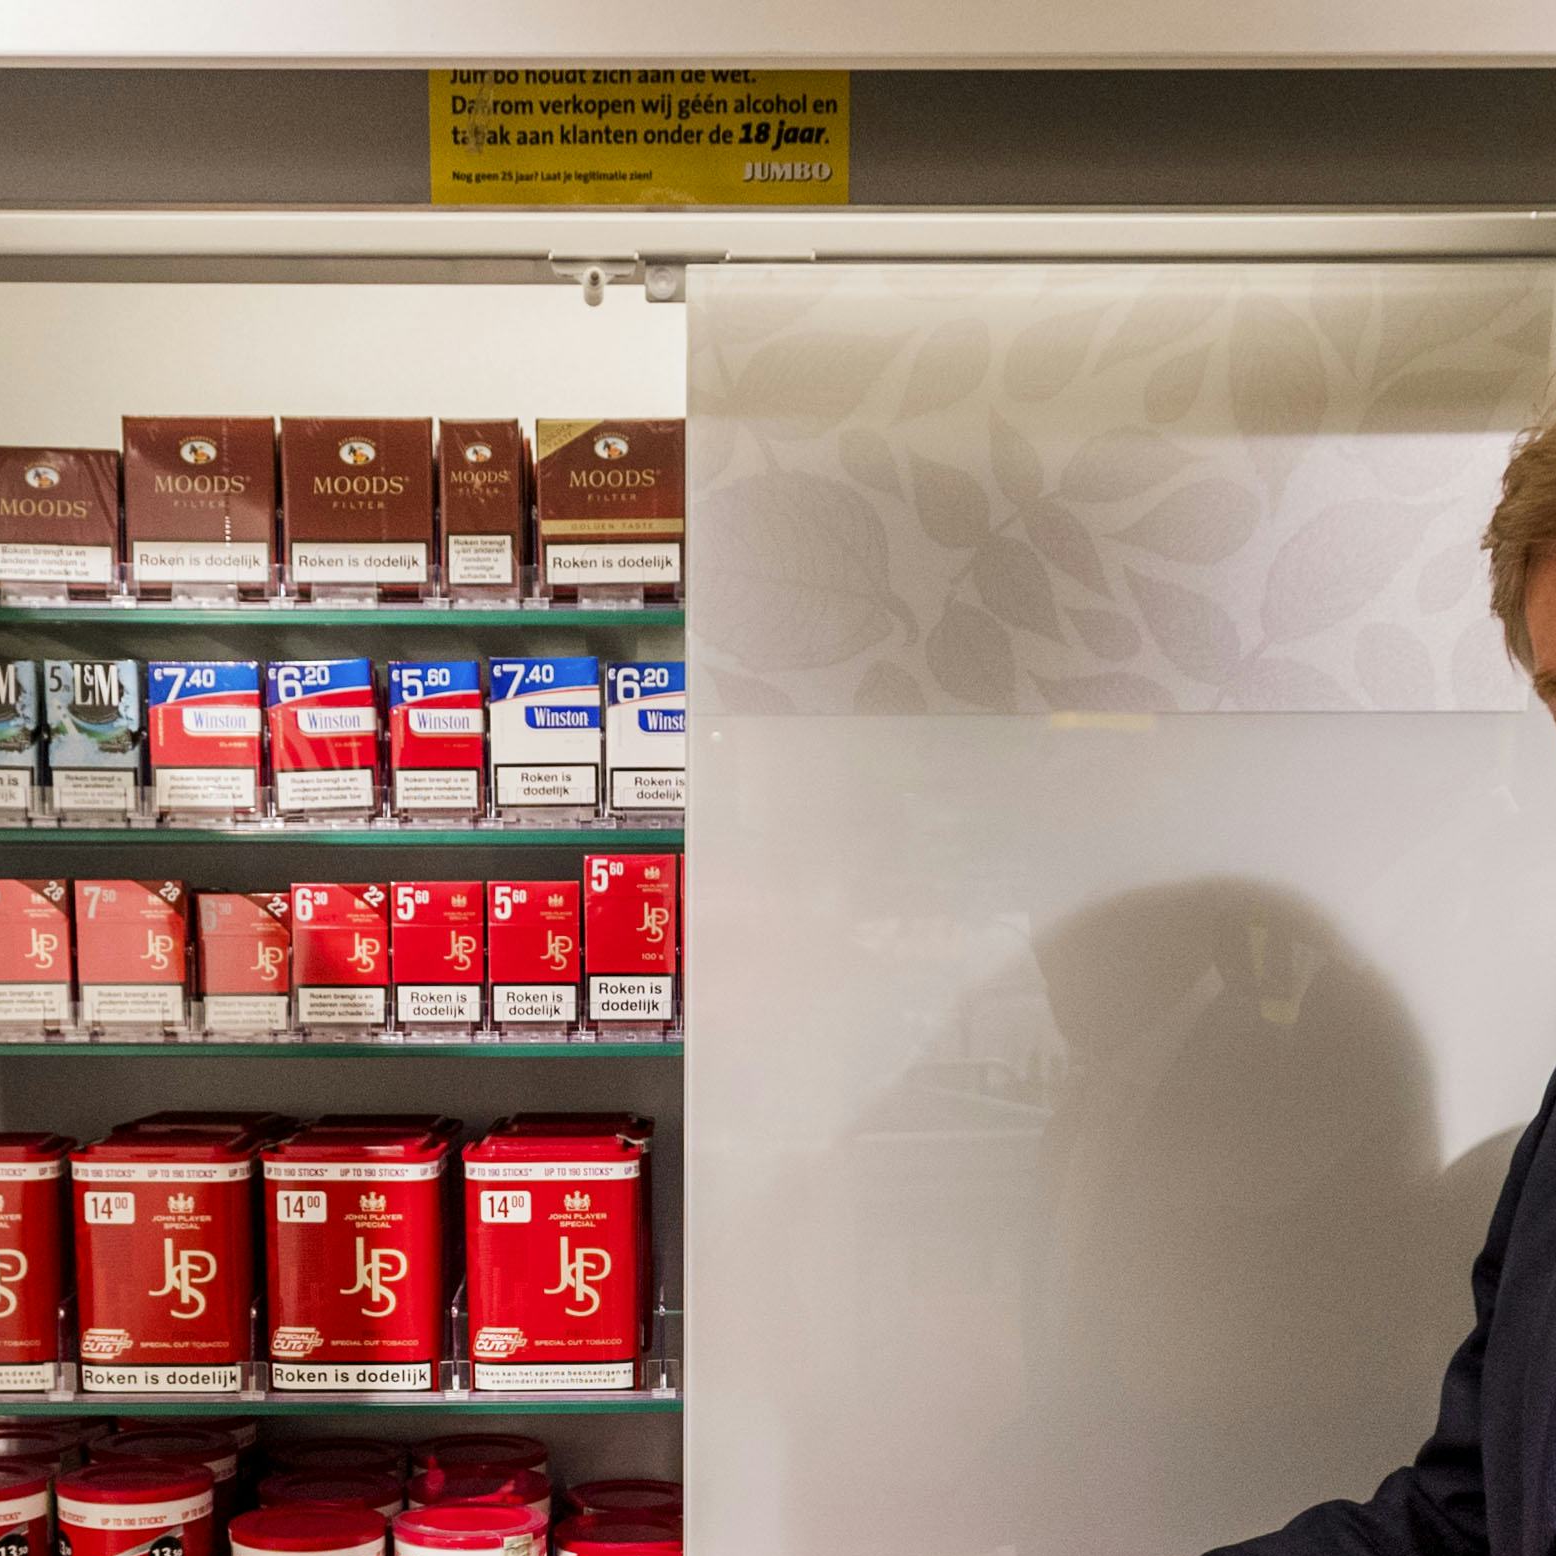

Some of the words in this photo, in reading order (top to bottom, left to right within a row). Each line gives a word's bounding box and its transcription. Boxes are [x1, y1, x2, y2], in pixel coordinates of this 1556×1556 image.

[525, 69, 586, 84] houdt
[592, 69, 631, 84] zich
[638, 69, 675, 84] aan
[681, 69, 706, 84] de
[712, 69, 757, 84] wet.
[451, 95, 534, 115] Darom
[539, 94, 635, 119] verkopen
[641, 94, 672, 120] wij
[678, 93, 728, 119] géén
[733, 94, 807, 114] alcohol
[812, 99, 837, 114] en
[516, 130, 554, 145] aan
[560, 125, 637, 145] klanten
[643, 124, 704, 145] onder
[708, 124, 734, 145] de
[739, 121, 771, 145] 18
[771, 120, 829, 151] jaar.
[452, 171, 473, 183] Nog
[743, 161, 833, 182] JUMBO
[154, 474, 246, 494] MOODS
[450, 469, 510, 484] MOODS
[569, 469, 656, 488] MOODS
[313, 476, 405, 495] MOODS
[0, 497, 89, 519] MOODS
[139, 553, 185, 567] Roken
[189, 554, 201, 567] is
[204, 554, 261, 569] dodelijk
[298, 556, 344, 568] Roken
[348, 555, 360, 568] is
[364, 555, 420, 570] dodelijk
[552, 556, 598, 569] Roken
[602, 556, 614, 569] is
[617, 555, 674, 570] dodelijk
[73, 663, 119, 707] L&M
[193, 711, 247, 729] Winston
[307, 711, 361, 729] Winston
[416, 712, 470, 730] Winston
[533, 706, 589, 727] Winston
[646, 710, 684, 731] Winst
[7, 773, 19, 786] is
[520, 772, 558, 782] Roken
[561, 772, 572, 782] is
[634, 776, 672, 786] Roken
[523, 785, 570, 797] dodelijk
[636, 789, 682, 800] dodelijk
[43, 880, 65, 902] 28
[158, 880, 181, 902] 28
[410, 991, 452, 1003] Roken
[456, 991, 468, 1003] is
[506, 991, 548, 1002] Roken
[552, 991, 563, 1002] is
[598, 982, 645, 995] Roken
[650, 982, 662, 995] is
[412, 1005, 465, 1019] dodelijk
[508, 1004, 561, 1018] dodelijk
[601, 999, 660, 1015] dodelijk
[84, 1369, 138, 1385] Roken
[144, 1370, 160, 1385] is
[166, 1369, 238, 1388] dodelijk
[274, 1367, 328, 1383] Roken
[334, 1368, 350, 1383] is
[355, 1367, 428, 1387] dodelijk
